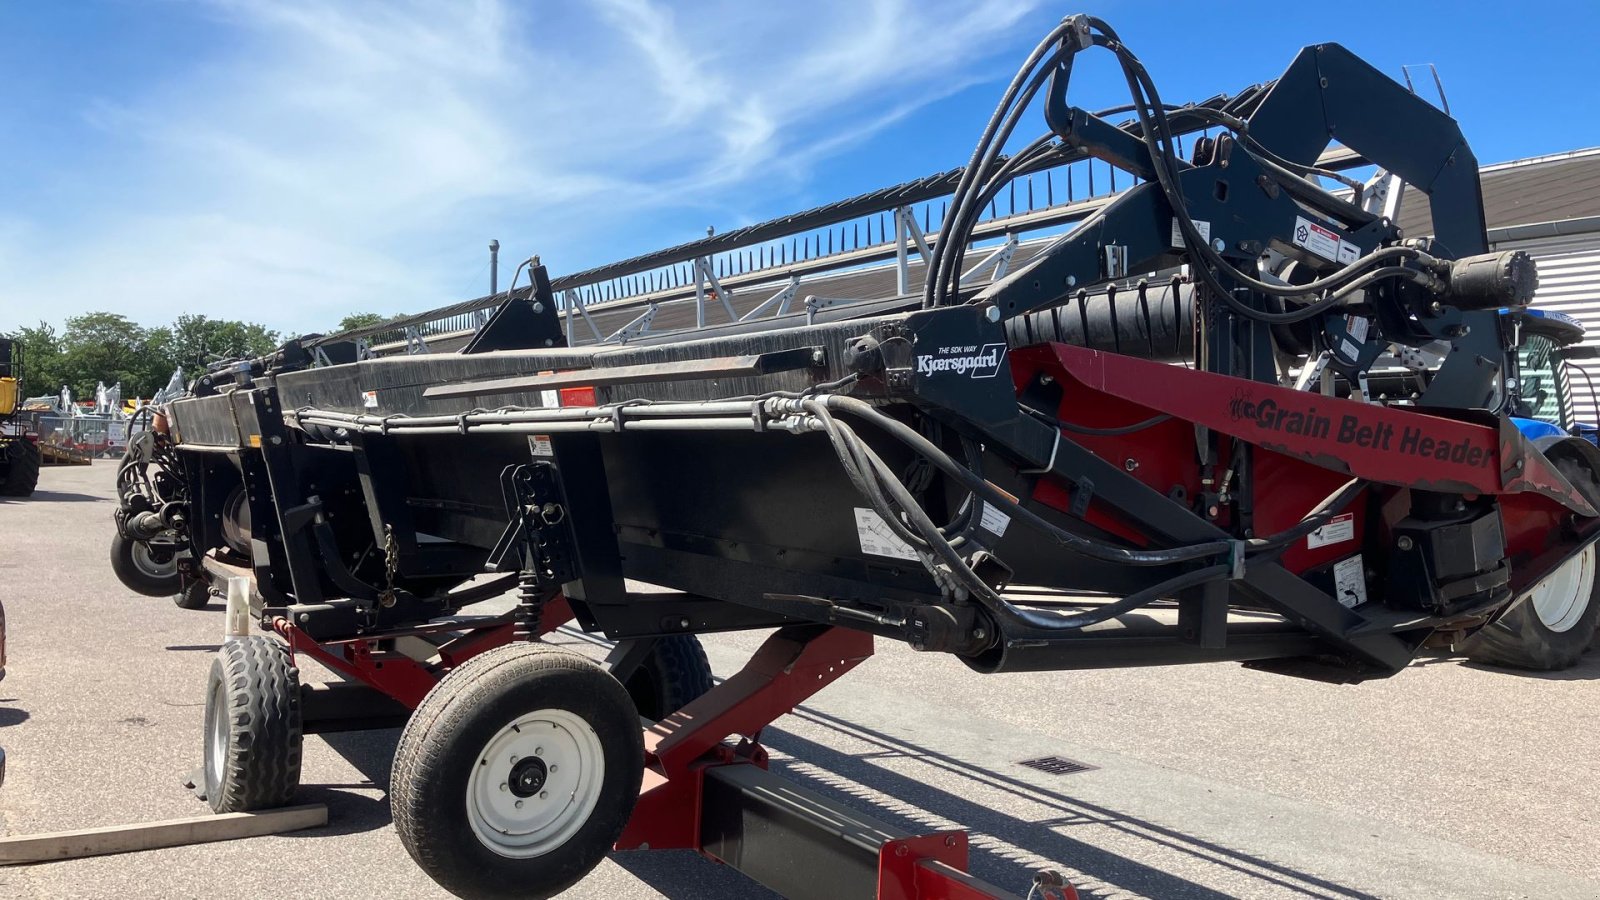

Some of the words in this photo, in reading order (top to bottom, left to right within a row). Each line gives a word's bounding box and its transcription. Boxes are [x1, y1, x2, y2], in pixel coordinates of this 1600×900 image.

[917, 348, 997, 377] Kjærsgaard
[950, 346, 962, 354] SDK
[963, 345, 978, 353] WAY
[1257, 398, 1329, 439] Grain
[1337, 415, 1394, 450] Belt
[1400, 426, 1494, 468] Header
